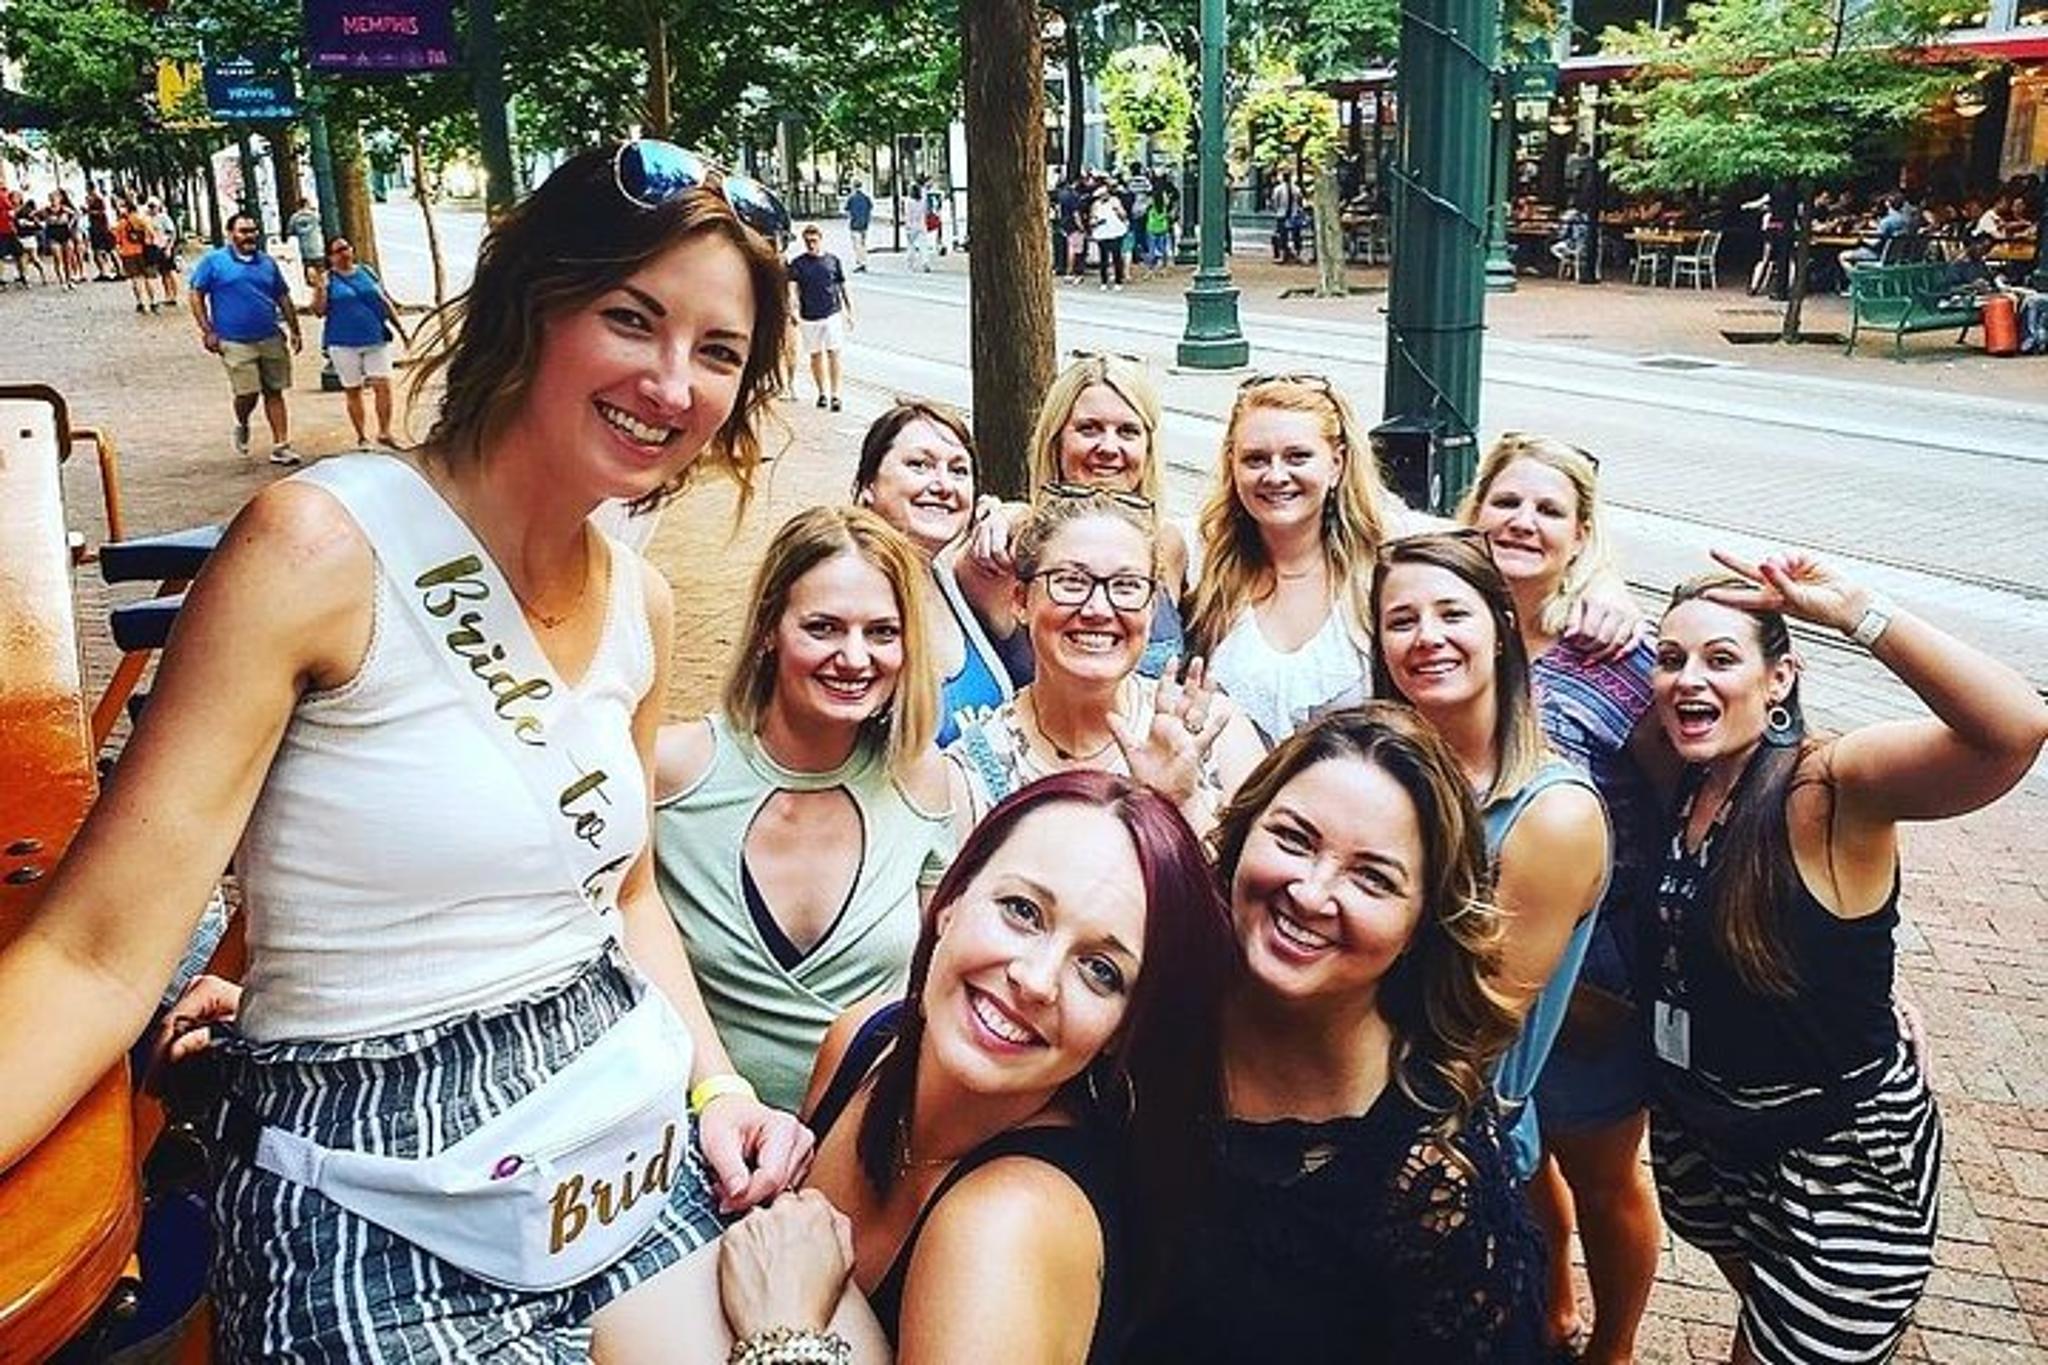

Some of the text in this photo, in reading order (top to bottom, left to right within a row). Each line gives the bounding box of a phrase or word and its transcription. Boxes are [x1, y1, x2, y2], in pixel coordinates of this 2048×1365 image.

[343, 15, 419, 36] MEMPHIS
[414, 553, 553, 746] Bride
[559, 748, 612, 851] to
